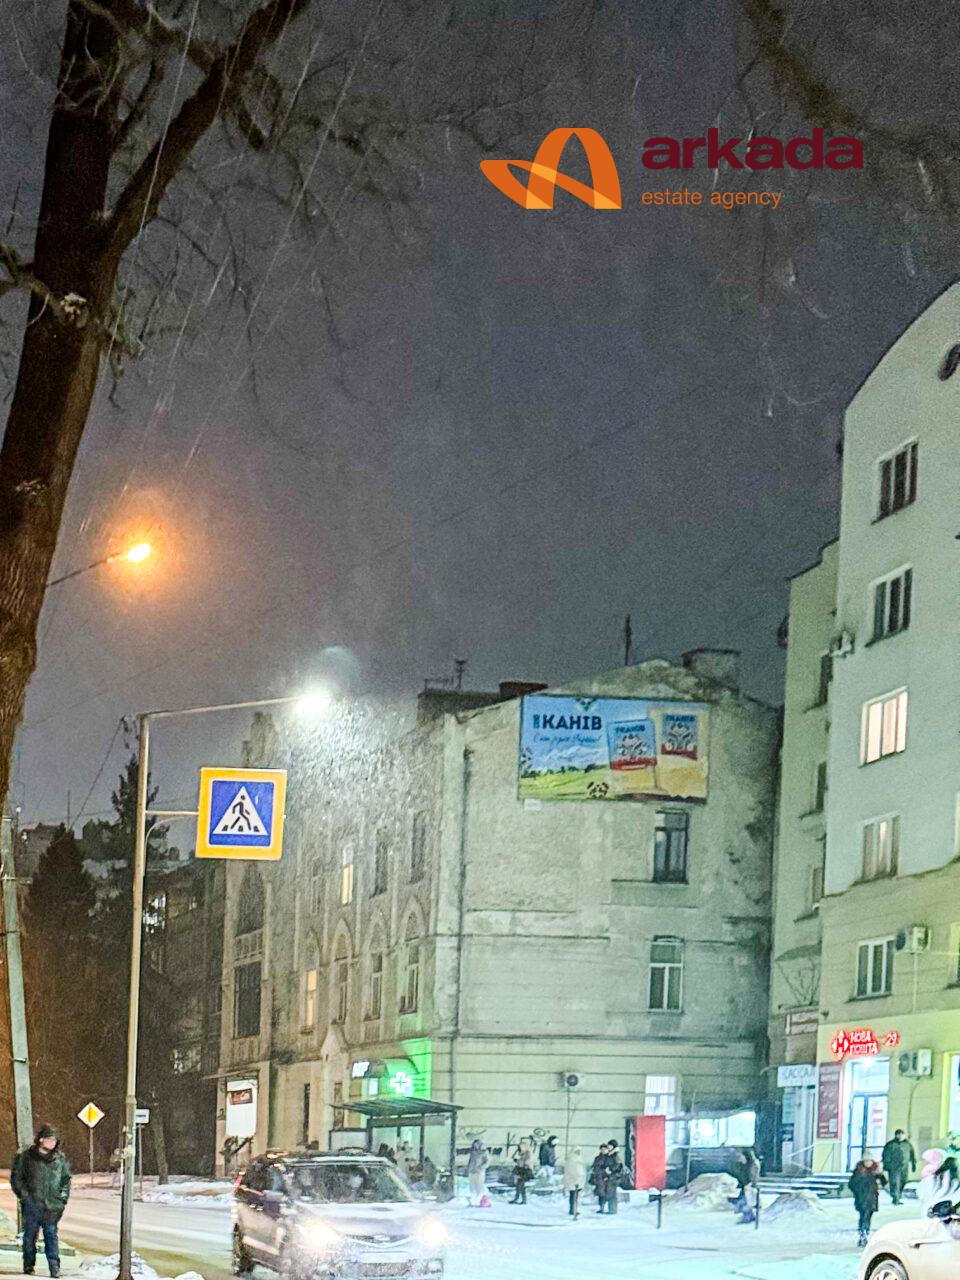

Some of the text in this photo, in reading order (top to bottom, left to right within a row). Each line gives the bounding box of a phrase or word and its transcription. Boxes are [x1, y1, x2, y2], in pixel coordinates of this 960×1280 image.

[542, 714, 602, 731] КАНІВ
[849, 1030, 872, 1042] НОВА
[849, 1042, 878, 1054] ПОШТА
